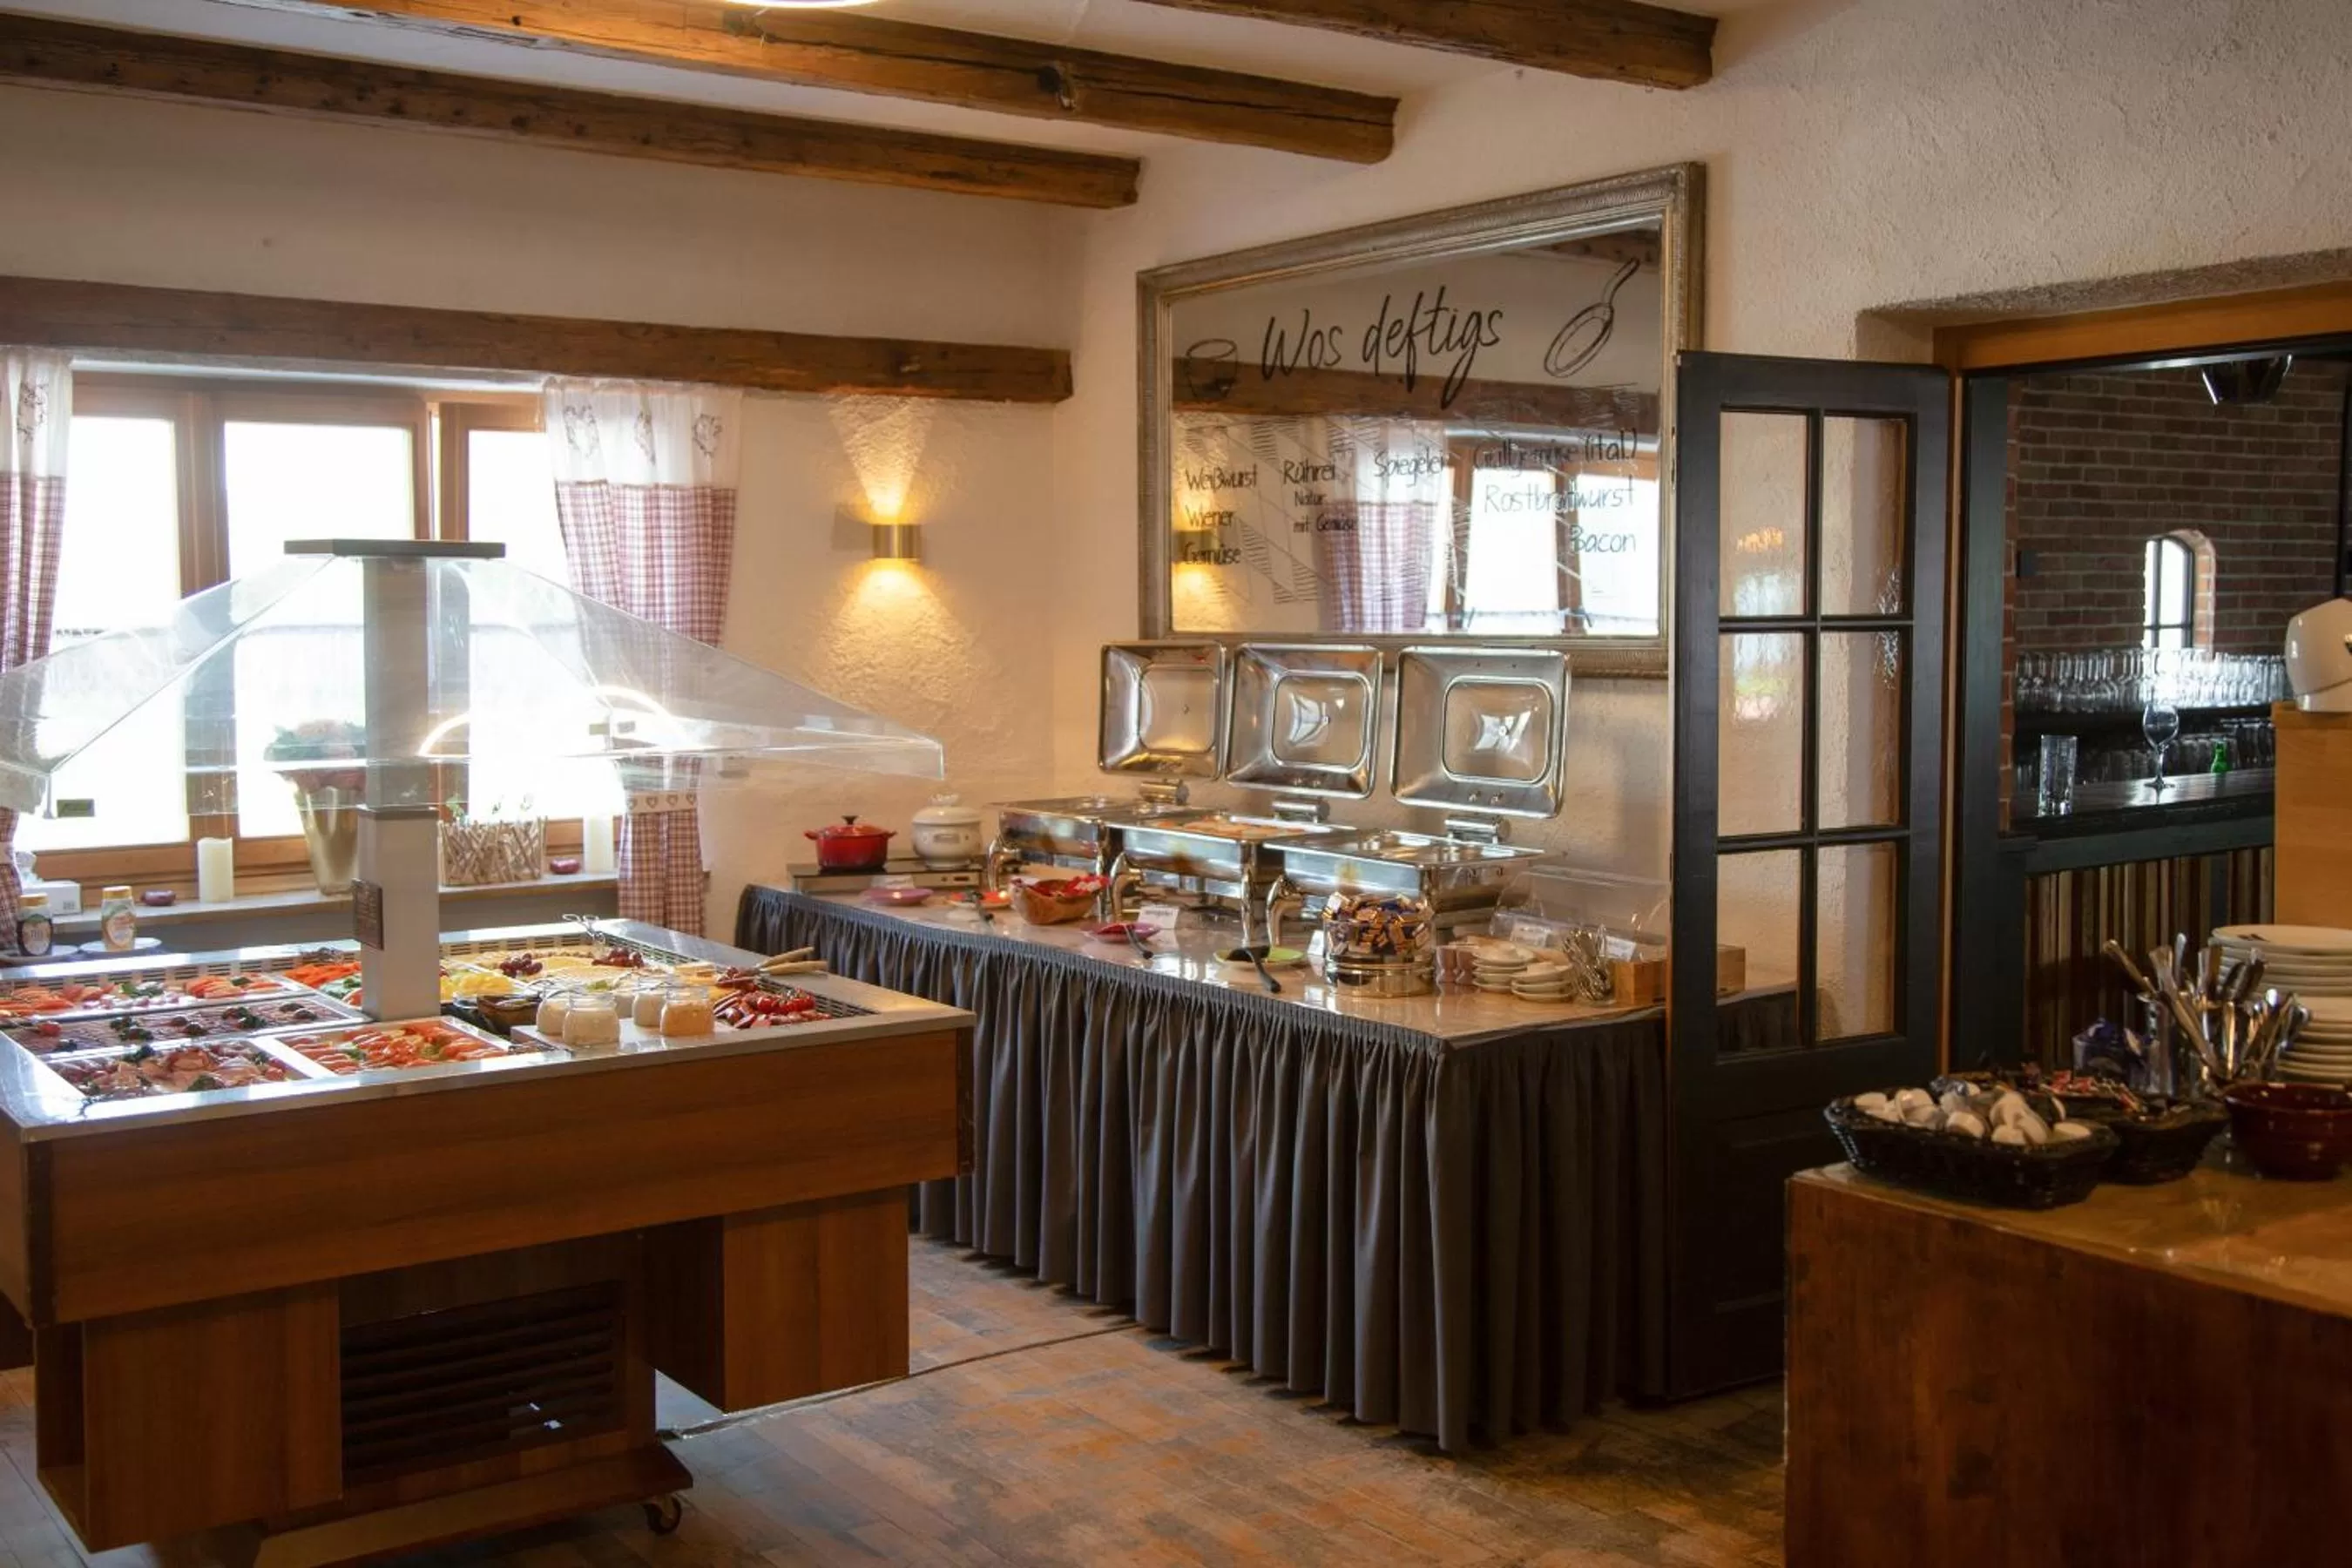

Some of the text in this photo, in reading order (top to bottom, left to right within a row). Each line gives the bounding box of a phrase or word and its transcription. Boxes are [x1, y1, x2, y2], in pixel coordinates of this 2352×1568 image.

[1260, 285, 1504, 409] Wos deftigs
[1283, 458, 1335, 483] Rührei
[1374, 445, 1443, 488] Spiegelei
[1570, 524, 1636, 553] Bacon
